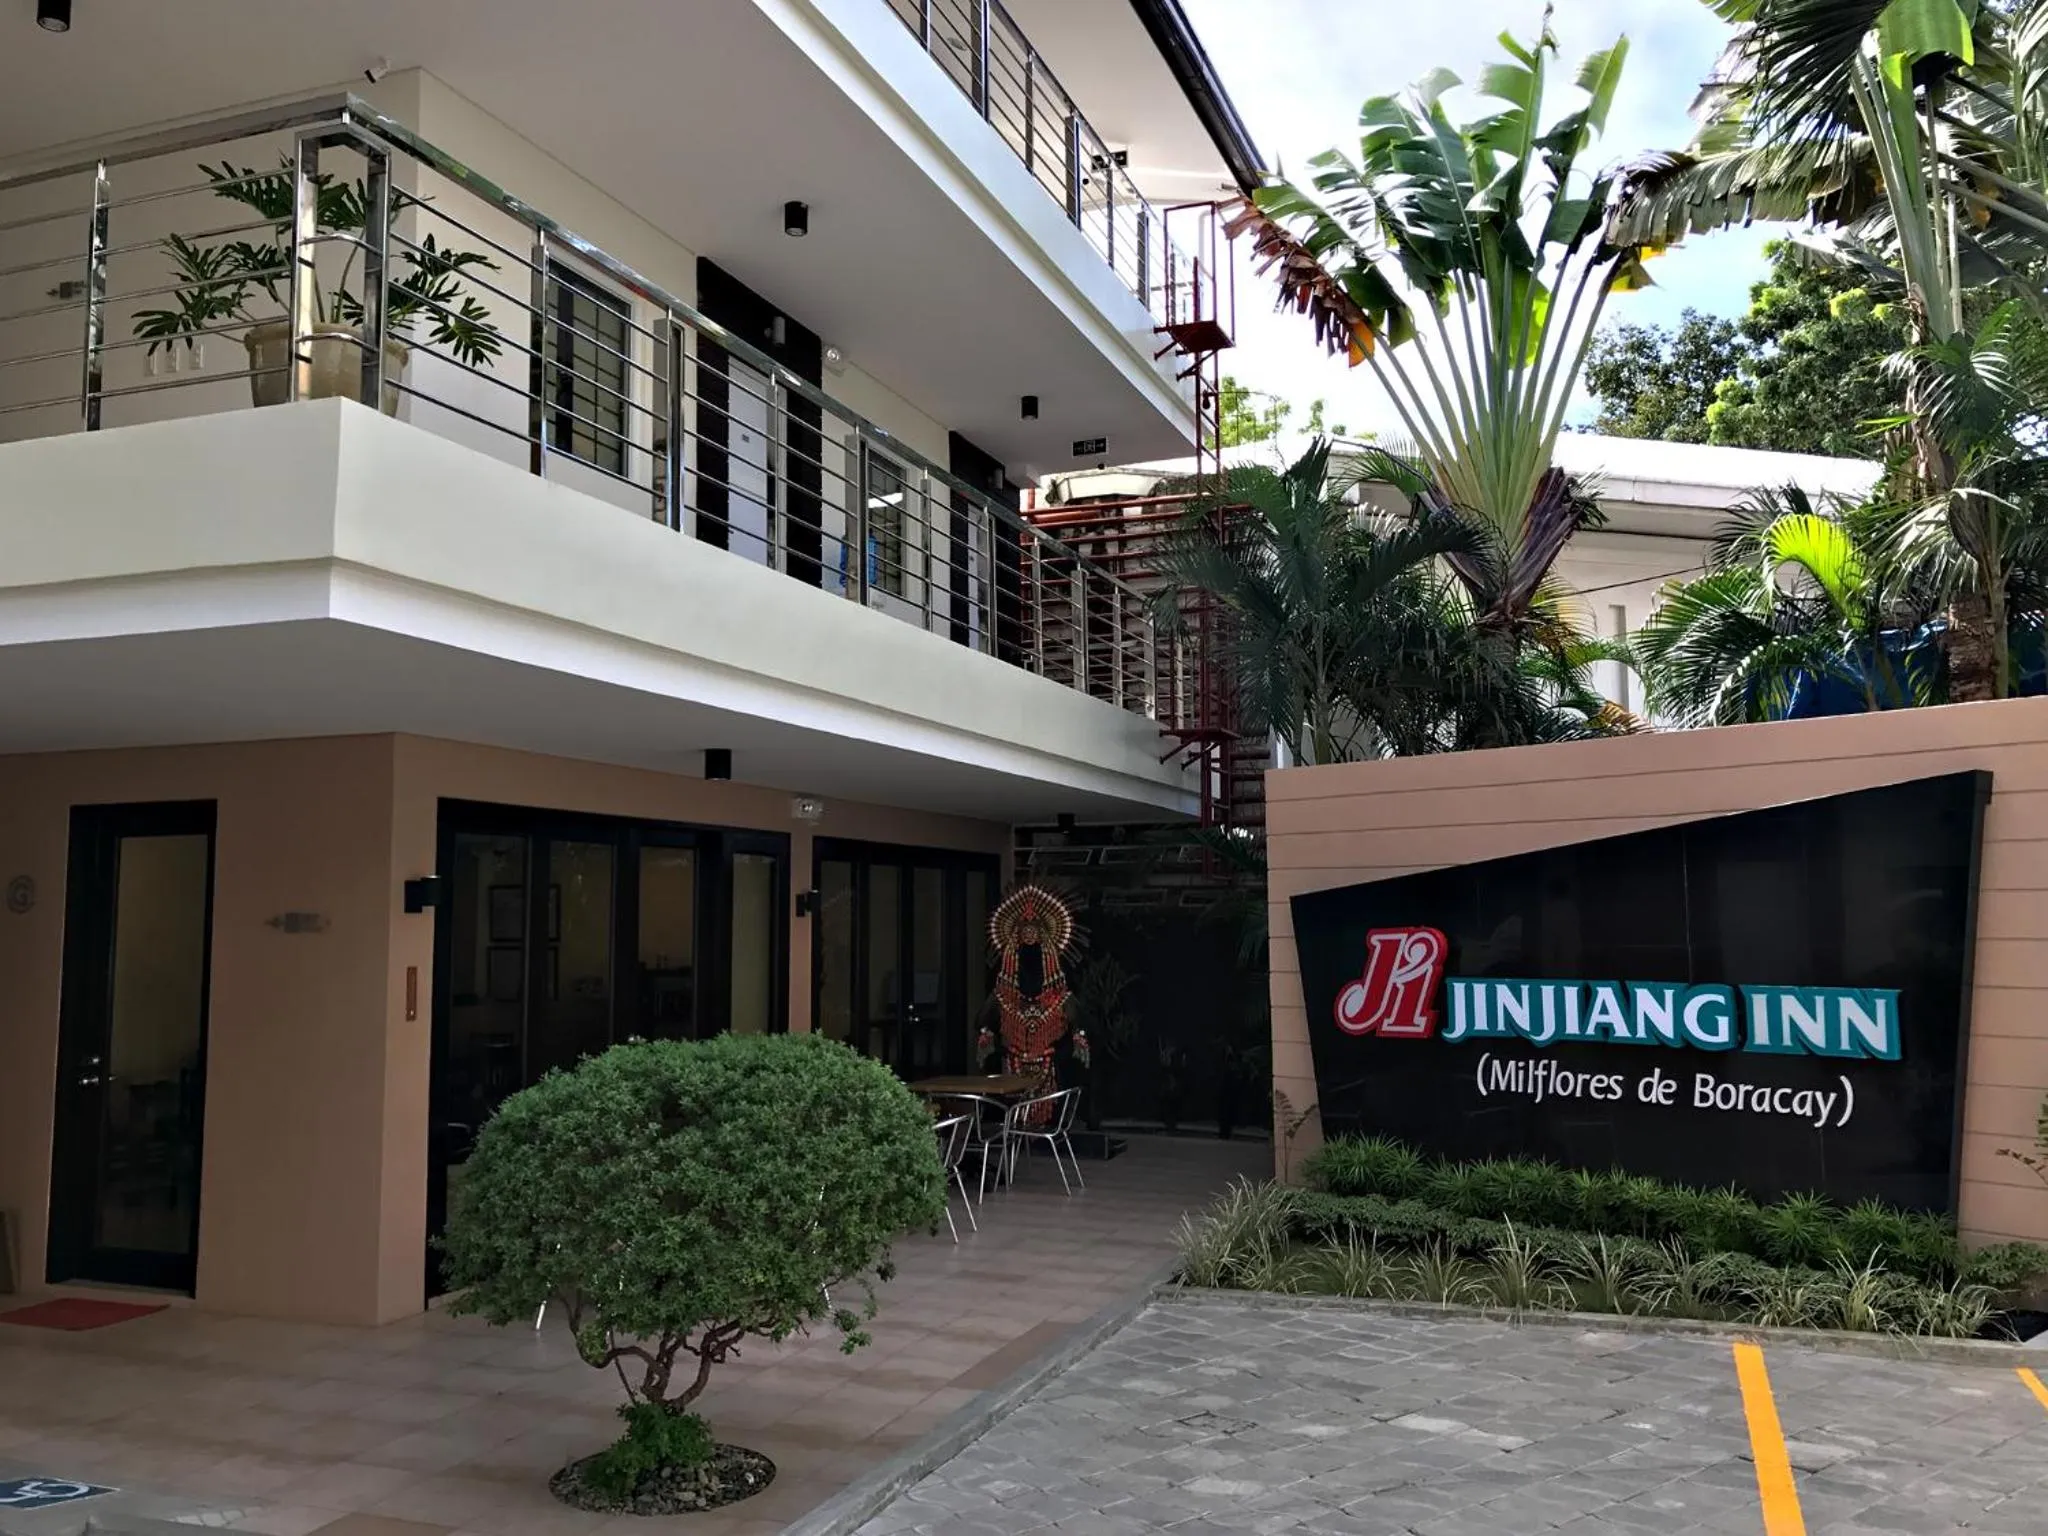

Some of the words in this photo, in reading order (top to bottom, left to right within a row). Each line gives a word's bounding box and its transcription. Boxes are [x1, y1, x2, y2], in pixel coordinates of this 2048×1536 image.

[1441, 982, 1729, 1043] JINJIANG
[1751, 993, 1888, 1053] INN
[1476, 1052, 1624, 1104] (Milflores
[1637, 1067, 1677, 1105] de
[1693, 1073, 1854, 1128] Boracay)
